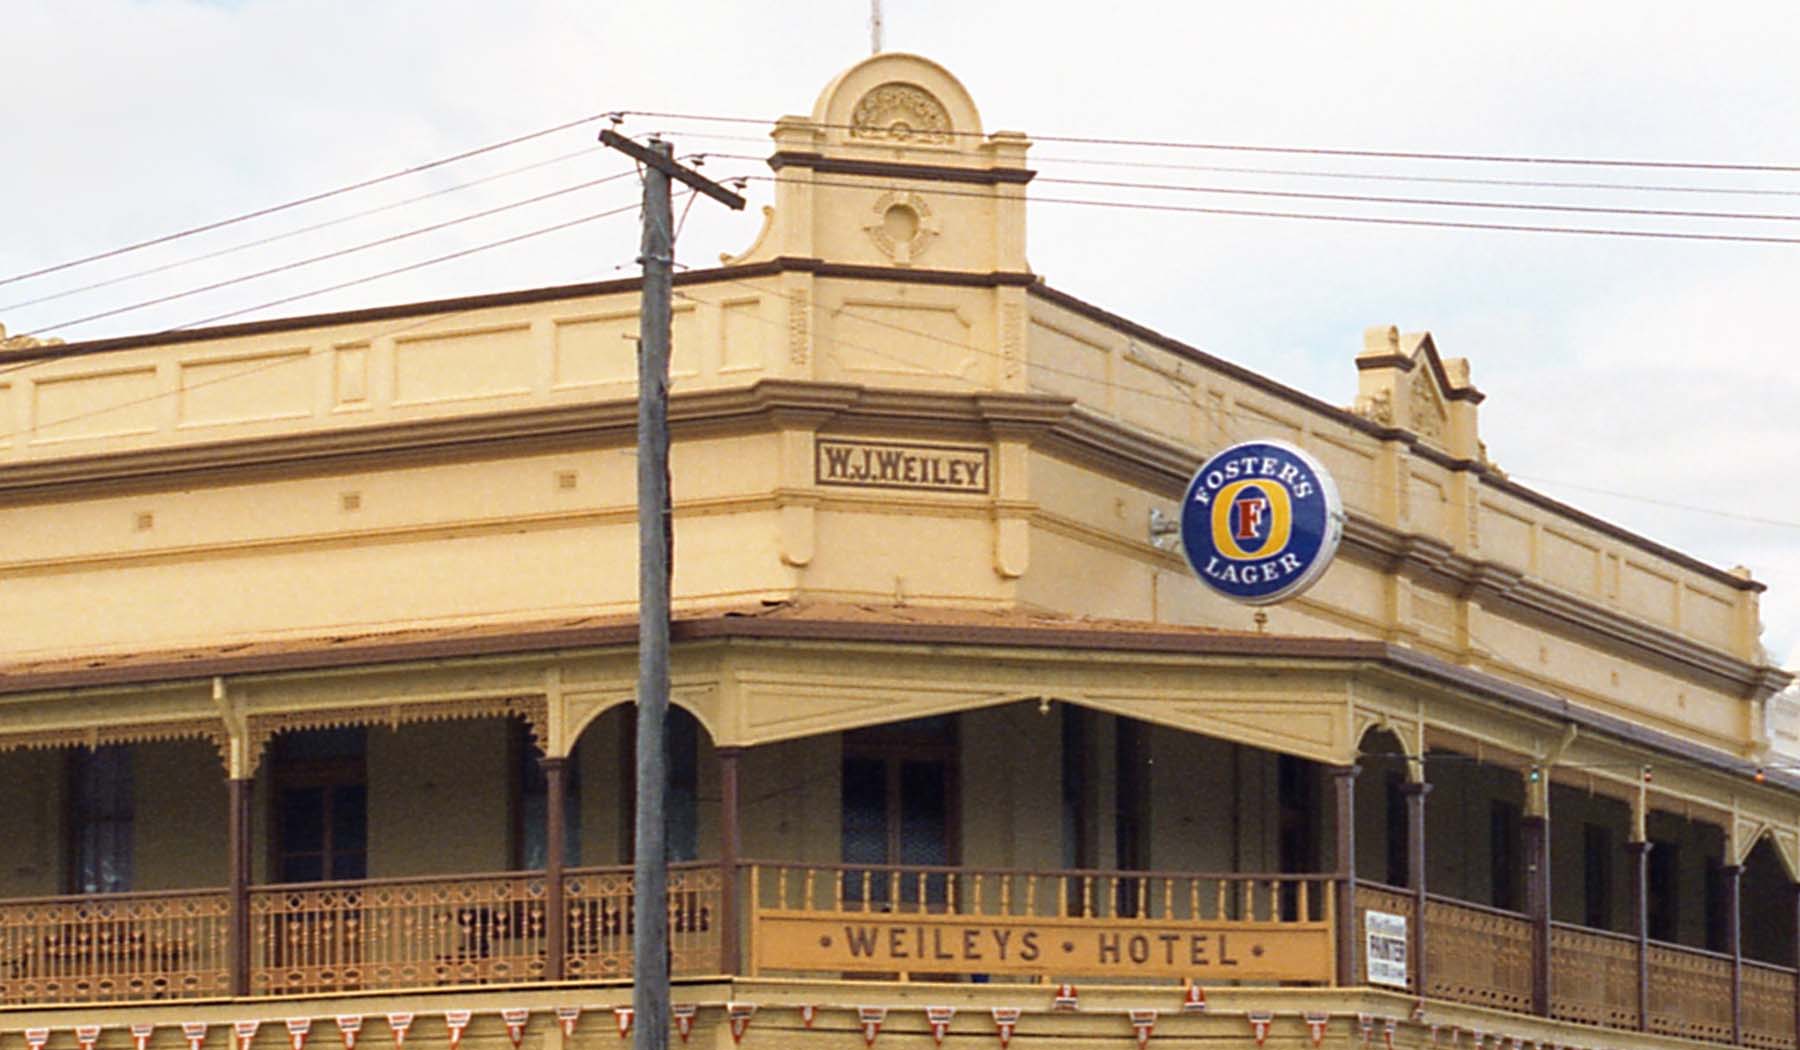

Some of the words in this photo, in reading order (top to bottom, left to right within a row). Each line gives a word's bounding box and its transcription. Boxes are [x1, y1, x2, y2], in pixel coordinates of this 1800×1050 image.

[1195, 457, 1313, 506] FOSTER'S
[1204, 552, 1303, 584] LAGER
[844, 926, 1040, 961] WEILEYS
[1098, 933, 1238, 966] HOTEL
